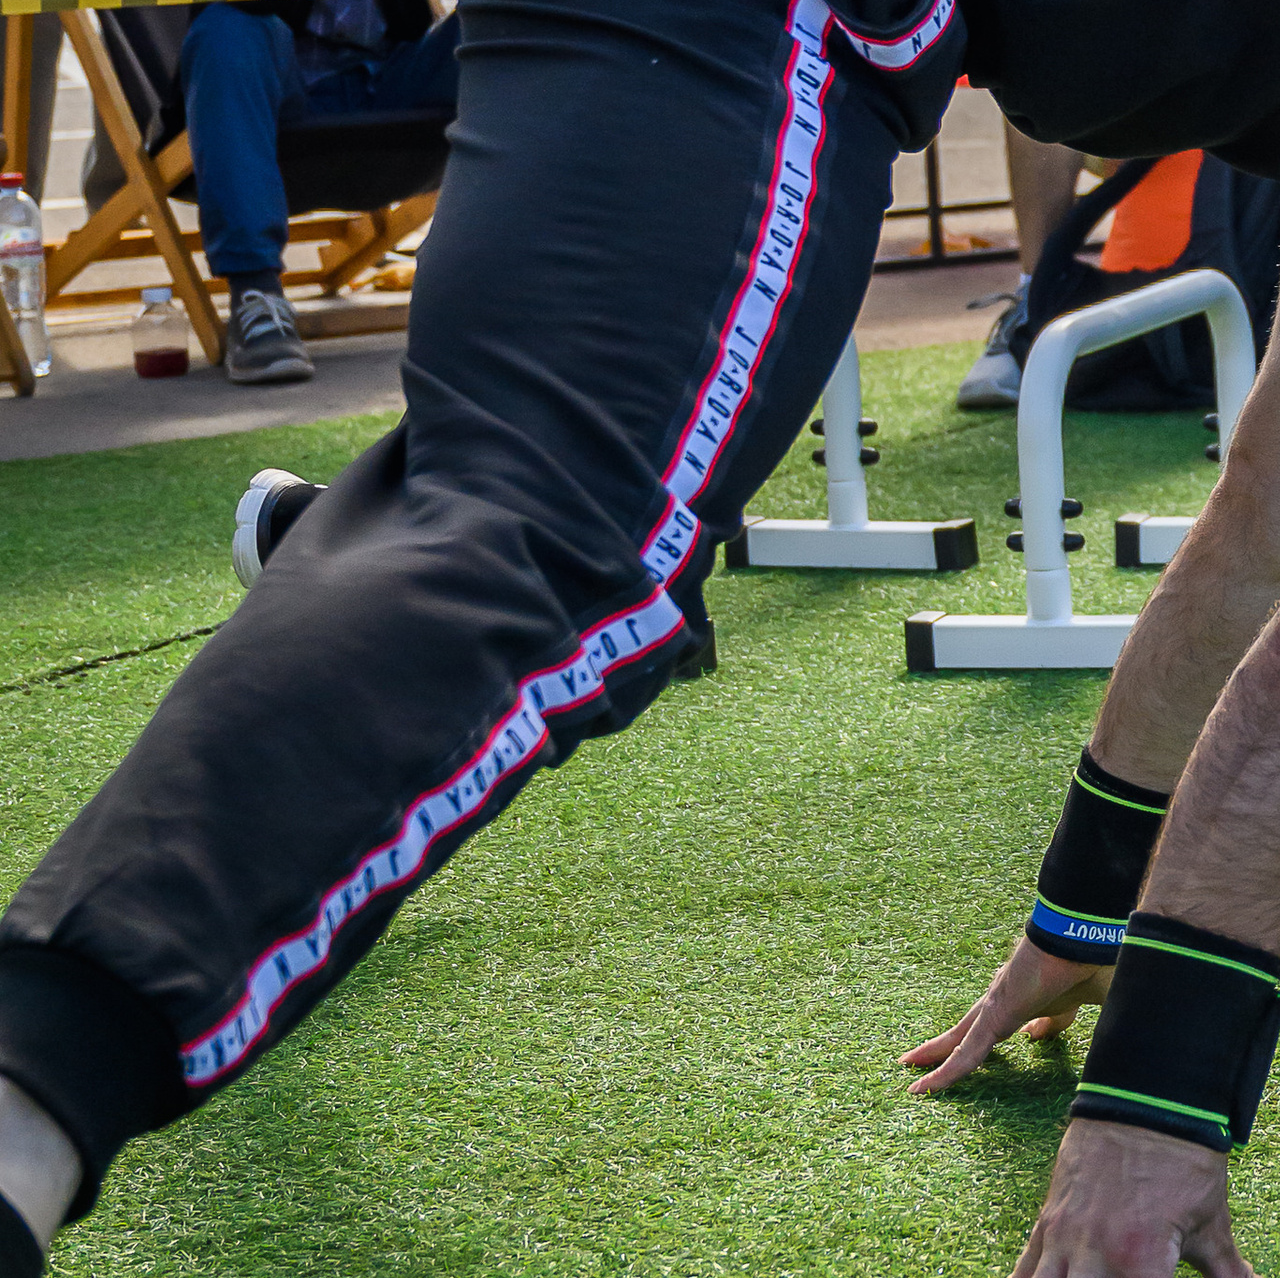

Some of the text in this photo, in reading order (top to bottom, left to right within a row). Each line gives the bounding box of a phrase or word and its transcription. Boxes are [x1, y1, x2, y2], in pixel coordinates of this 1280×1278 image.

[754, 160, 810, 303] JORDAN
[684, 324, 758, 476] JORDAN
[1063, 922, 1126, 944] ORKOUT
